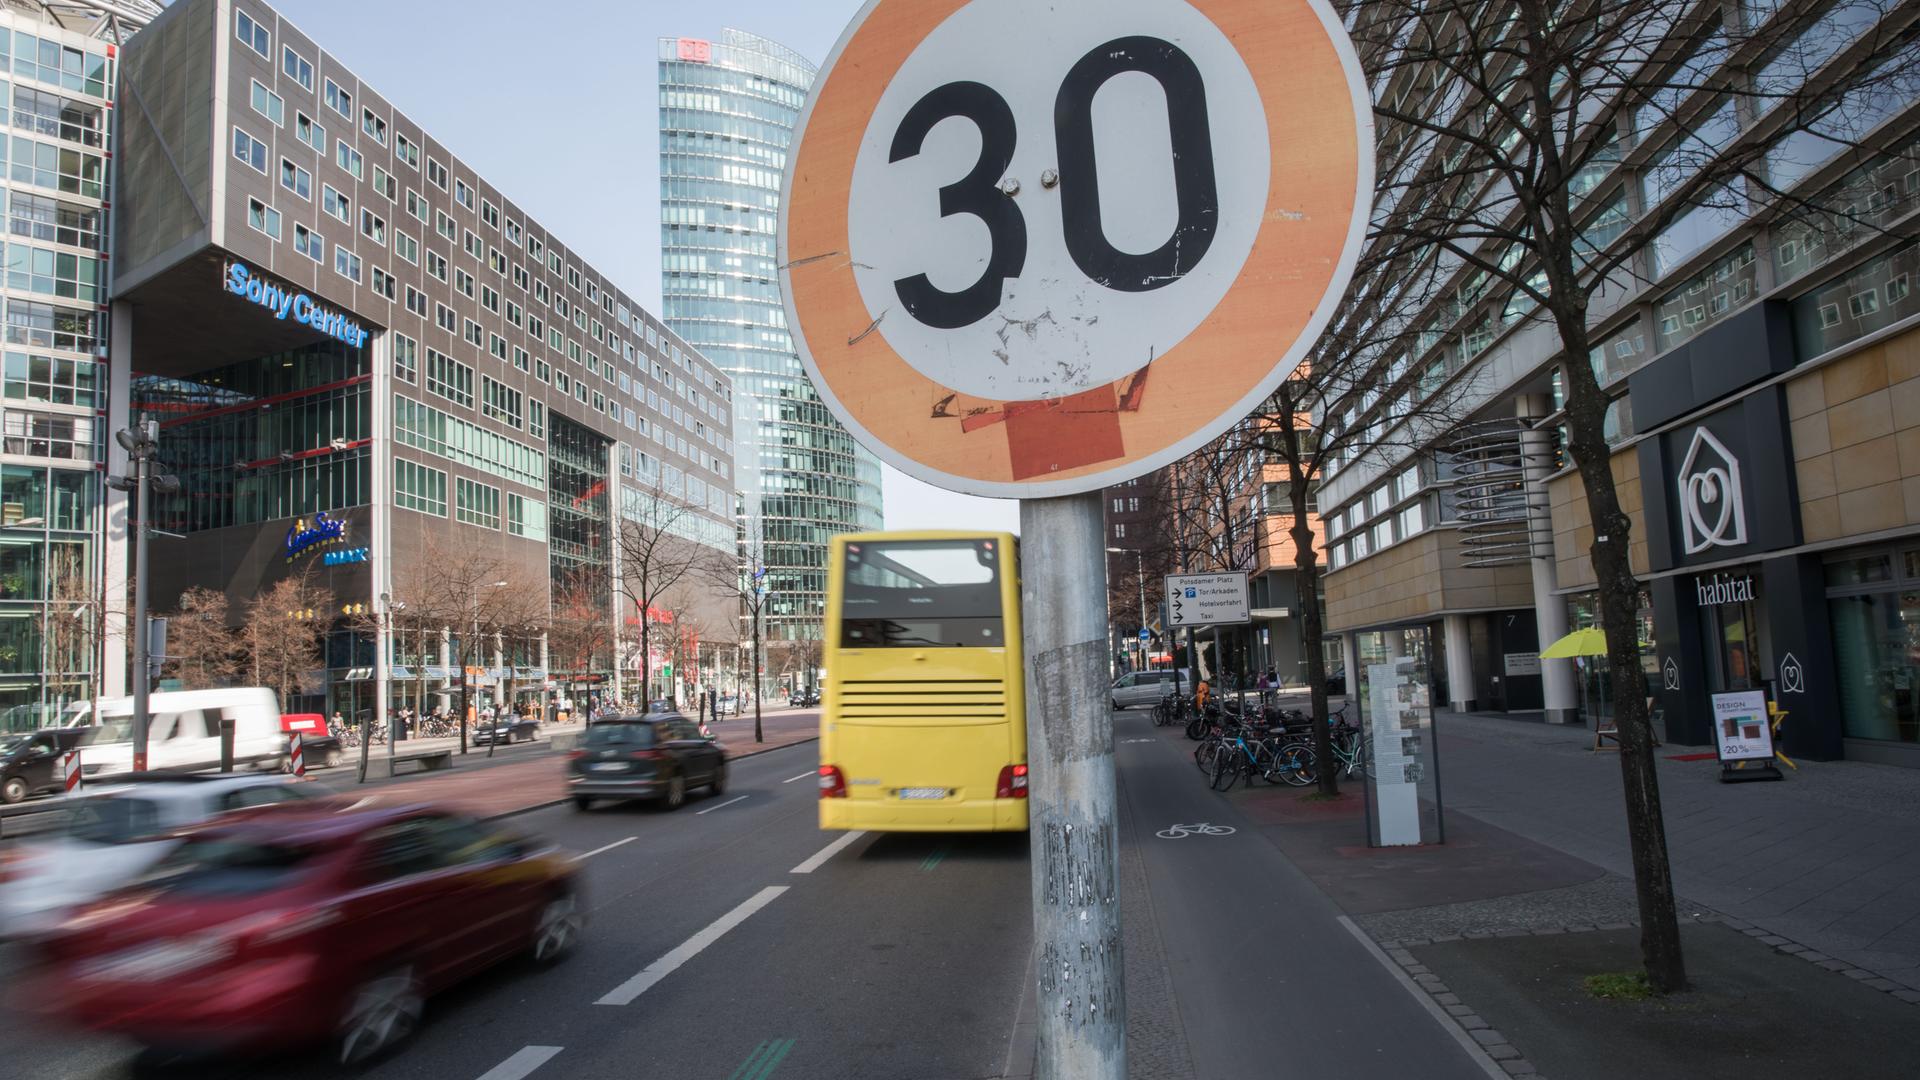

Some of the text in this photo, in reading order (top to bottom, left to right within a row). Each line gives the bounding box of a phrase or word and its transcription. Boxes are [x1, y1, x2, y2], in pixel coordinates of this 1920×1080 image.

[888, 35, 1219, 330] 30
[228, 263, 369, 349] Sony Center
[1199, 588, 1238, 596] Tor/Arkaden
[1696, 572, 1755, 606] habitat
[1199, 600, 1242, 608] Hotelvorfahrt
[1200, 612, 1214, 620] Taxi
[1506, 614, 1516, 627] 7
[1716, 701, 1746, 710] DESIGN
